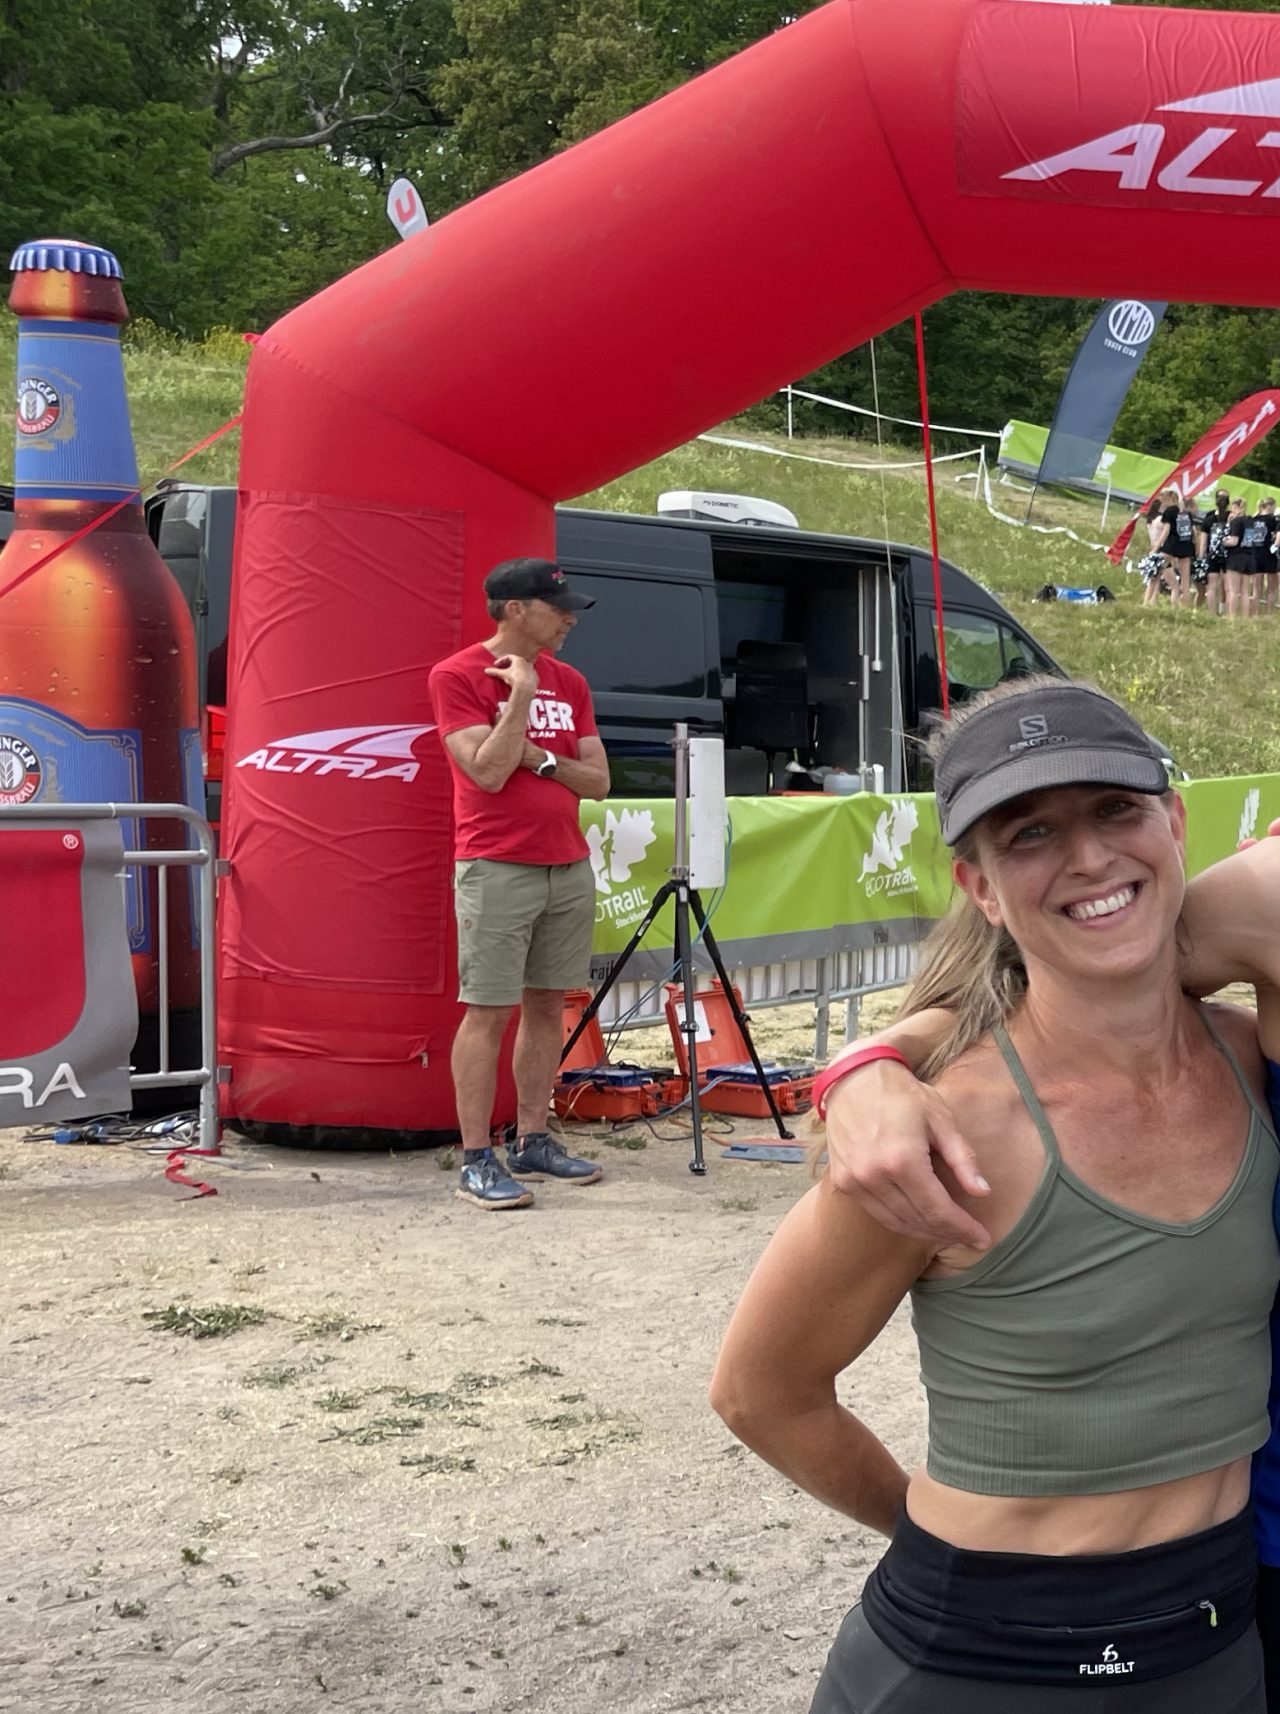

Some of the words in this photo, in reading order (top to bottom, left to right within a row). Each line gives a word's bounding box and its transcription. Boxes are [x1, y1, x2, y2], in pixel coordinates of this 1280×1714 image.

[235, 749, 421, 783] ALTRA
[591, 959, 615, 982] rail
[0, 1063, 87, 1109] RA
[1079, 1661, 1135, 1675] FLIPBELT
